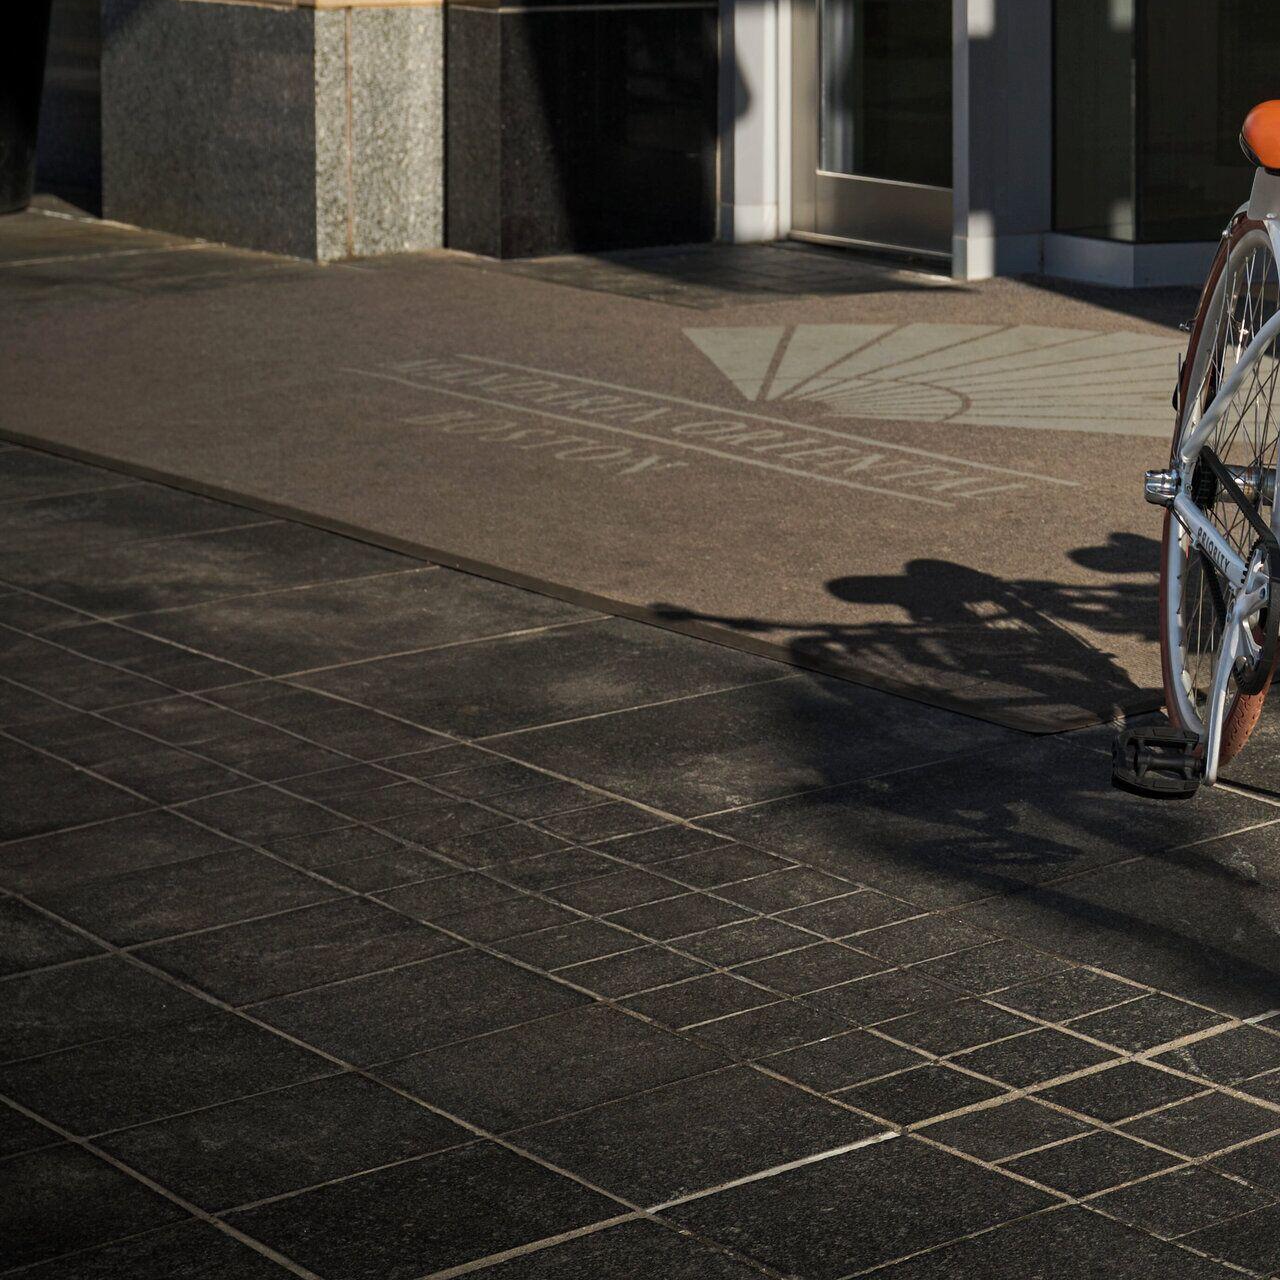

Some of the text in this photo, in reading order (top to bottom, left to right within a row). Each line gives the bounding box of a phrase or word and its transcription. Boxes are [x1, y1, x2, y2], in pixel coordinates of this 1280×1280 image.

[391, 358, 1029, 499] MANDARIN ORIENTAL
[399, 410, 689, 476] BOSTON
